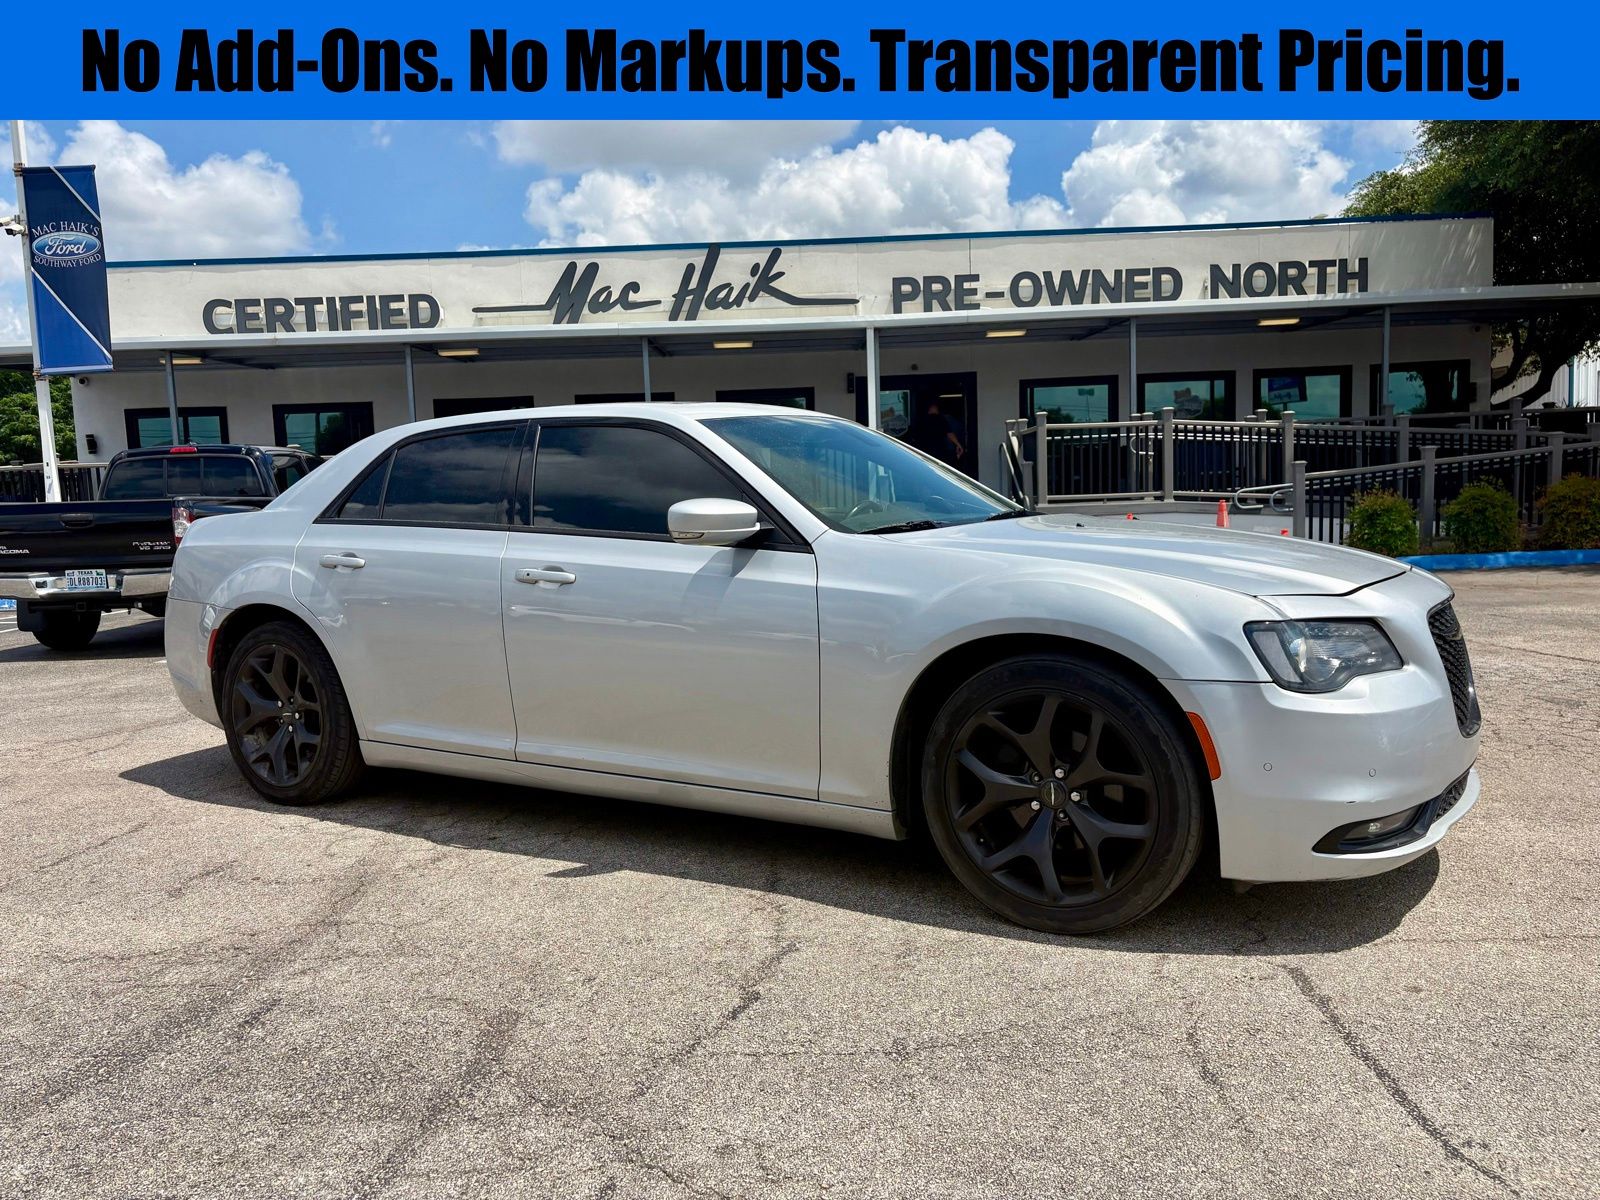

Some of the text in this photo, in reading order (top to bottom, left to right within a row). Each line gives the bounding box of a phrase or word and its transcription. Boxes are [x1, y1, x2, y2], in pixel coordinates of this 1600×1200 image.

[32, 221, 99, 238] MAC HAIK'S
[34, 253, 101, 267] SOUTHWAY FORD
[45, 236, 86, 255] Ford
[472, 245, 860, 325] Mac Haik
[891, 257, 1369, 314] PRE-OWNED NORTH
[202, 293, 441, 336] CERTIFIED
